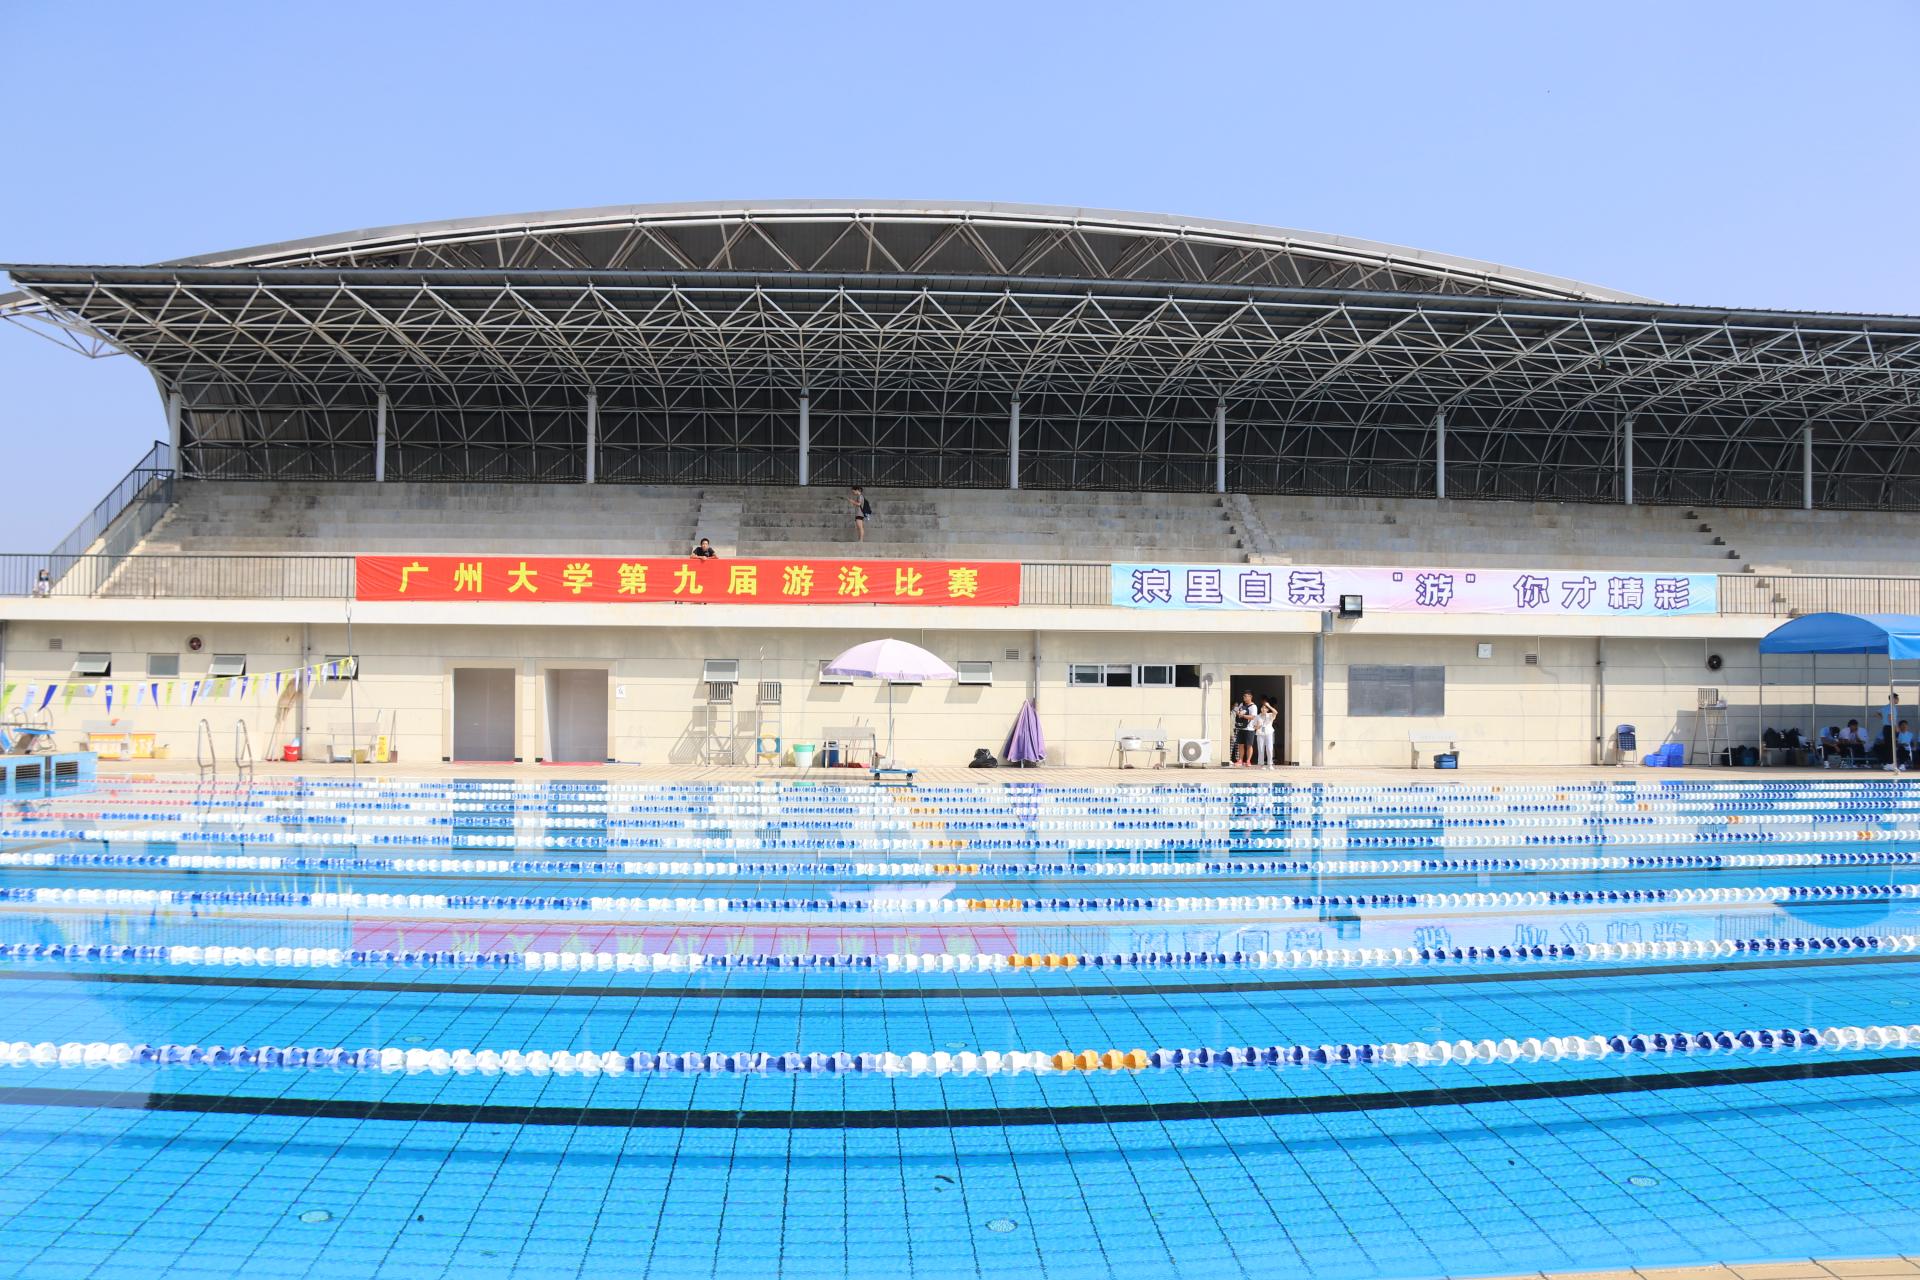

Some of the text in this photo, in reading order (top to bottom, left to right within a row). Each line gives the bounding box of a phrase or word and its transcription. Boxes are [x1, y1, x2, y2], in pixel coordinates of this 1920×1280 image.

[399, 561, 978, 598] 广州大学第九届游泳比赛
